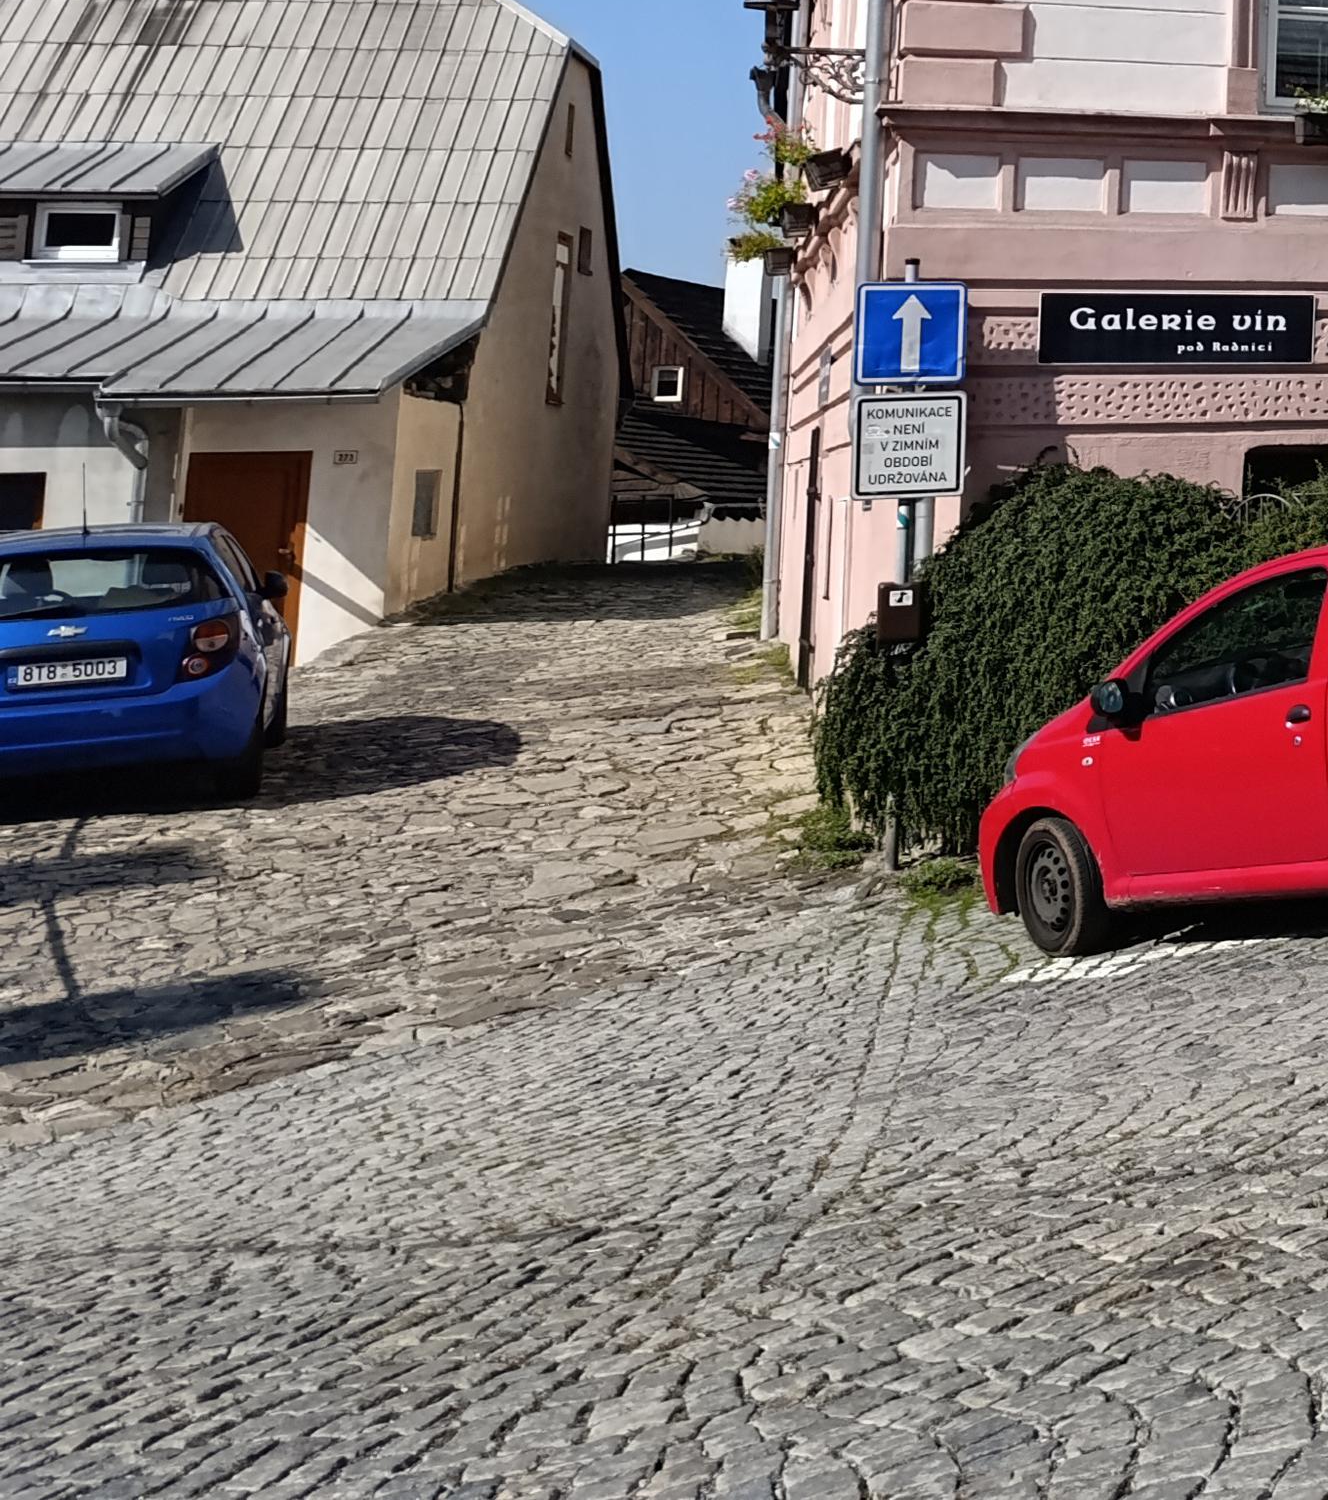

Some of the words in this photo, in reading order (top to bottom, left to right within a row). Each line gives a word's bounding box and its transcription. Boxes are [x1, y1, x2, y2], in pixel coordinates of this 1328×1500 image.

[1069, 307, 1216, 330] Galerie
[1177, 341, 1204, 355] pod
[867, 406, 952, 420] KOMUNIKACE
[893, 421, 925, 435] NENÍ
[880, 441, 889, 451] V
[892, 438, 939, 452] ZIMNÍM
[884, 454, 932, 468] OBDOBÍ
[868, 471, 947, 485] UDRŽOVÁNA
[23, 664, 57, 682] 8T8
[72, 660, 117, 678] 5003
